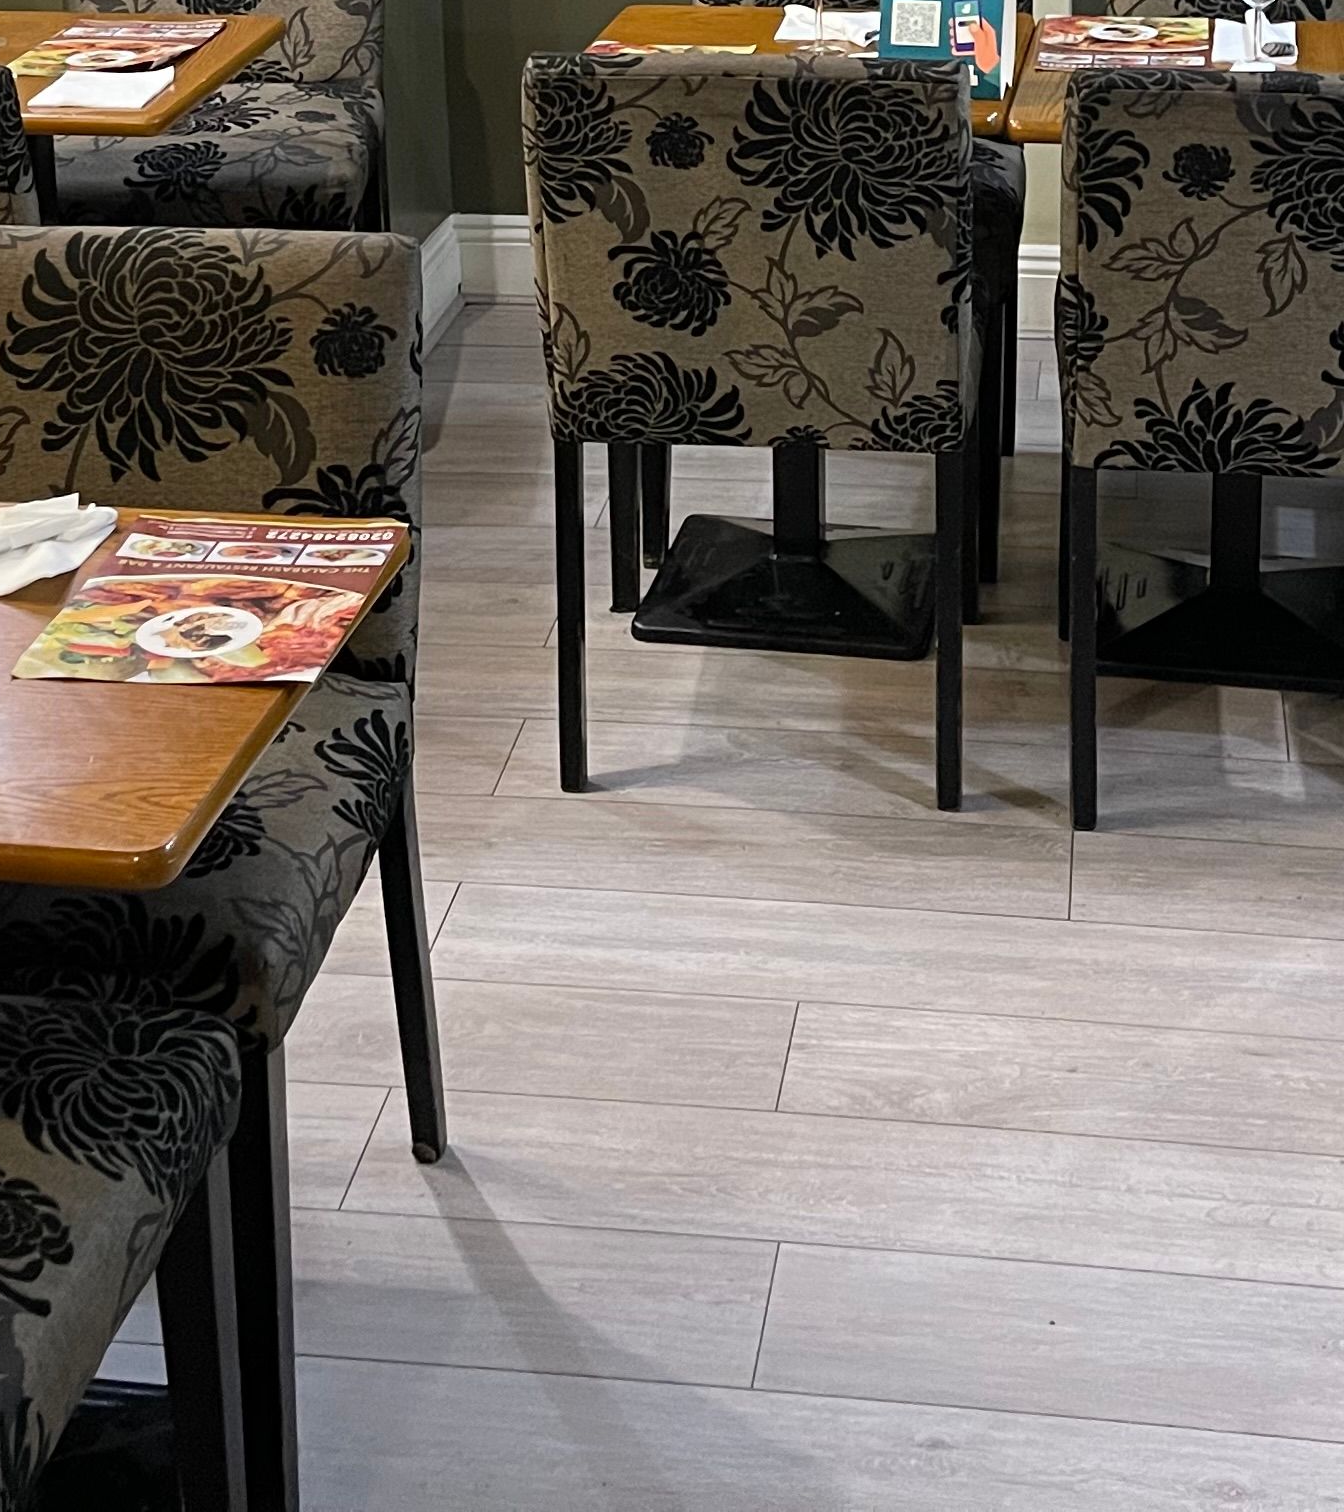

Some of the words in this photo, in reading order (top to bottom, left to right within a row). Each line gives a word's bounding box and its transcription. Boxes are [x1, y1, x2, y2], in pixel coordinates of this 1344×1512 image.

[265, 531, 395, 541] 02082484272
[166, 562, 259, 572] RESTAURANT
[262, 566, 340, 574] CALABASH
